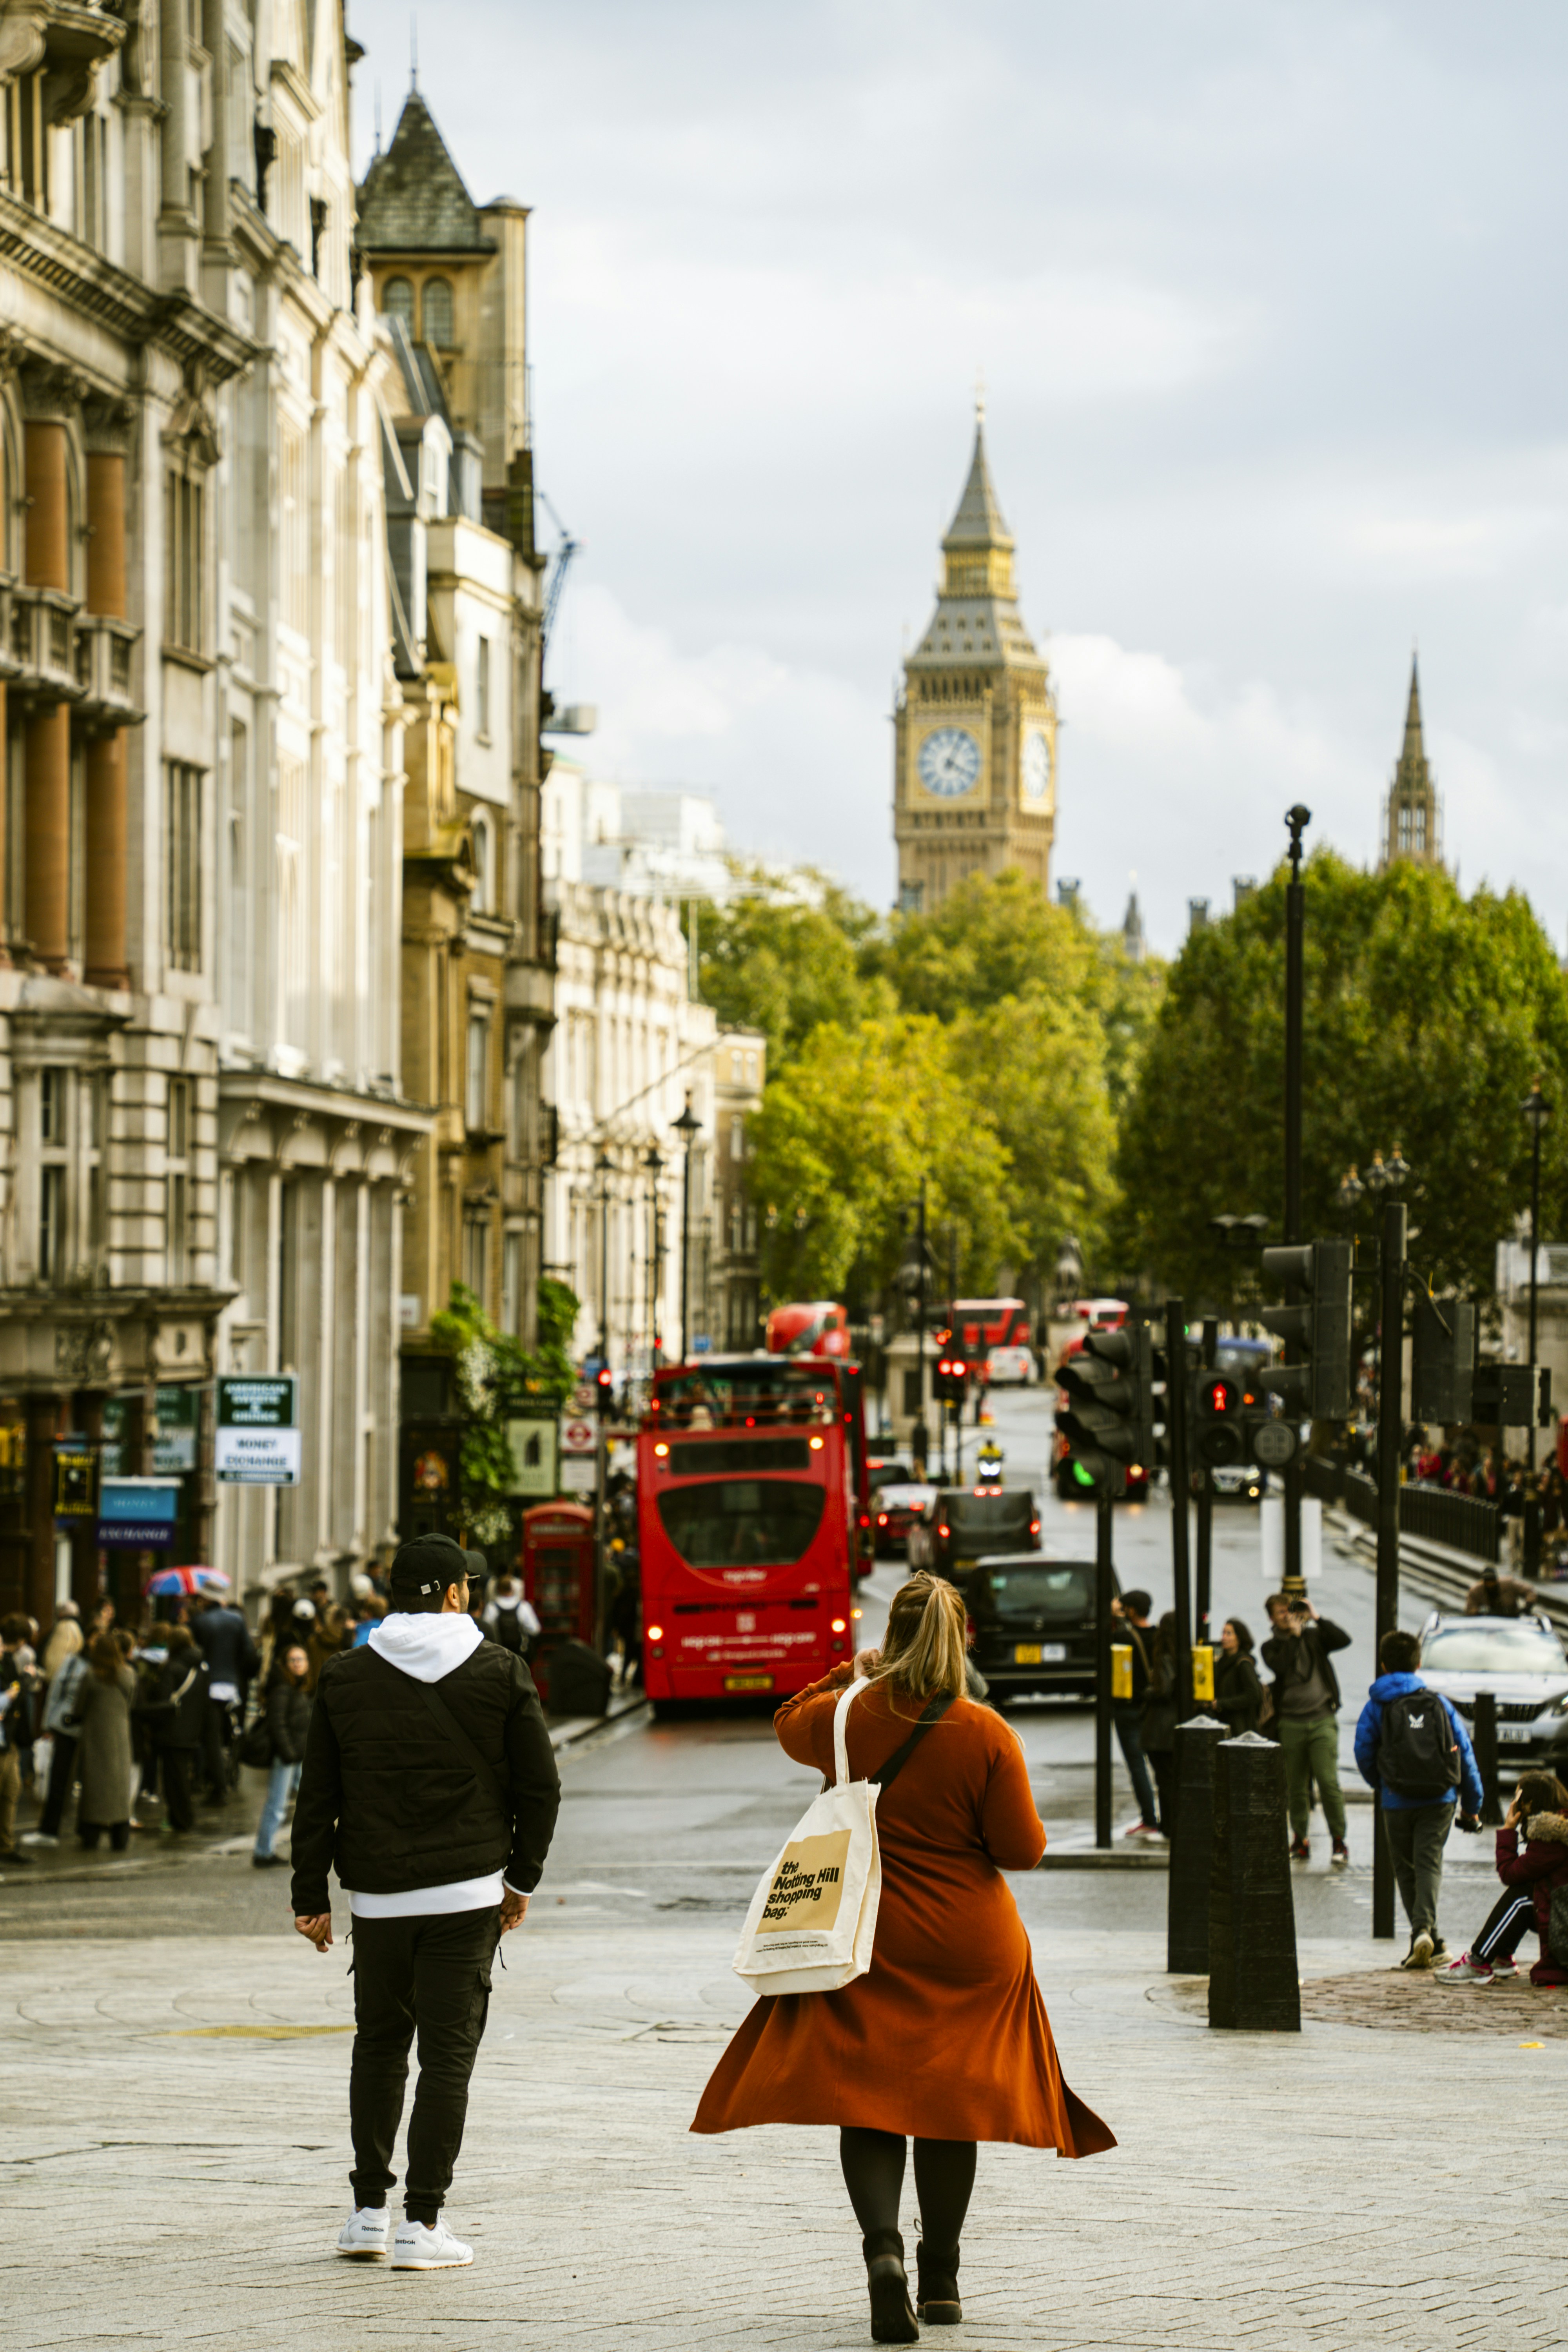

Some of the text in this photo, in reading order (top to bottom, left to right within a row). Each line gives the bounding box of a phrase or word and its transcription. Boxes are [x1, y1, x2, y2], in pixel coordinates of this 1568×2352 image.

[224, 1383, 288, 1394] AMERICAN
[237, 1439, 276, 1450] MONEY
[226, 1455, 287, 1466] EXCHANGE
[99, 1528, 169, 1541] EXCHANGE
[781, 1861, 799, 1875] the
[773, 1867, 840, 1890] Notting Hill
[768, 1887, 822, 1905] shopping
